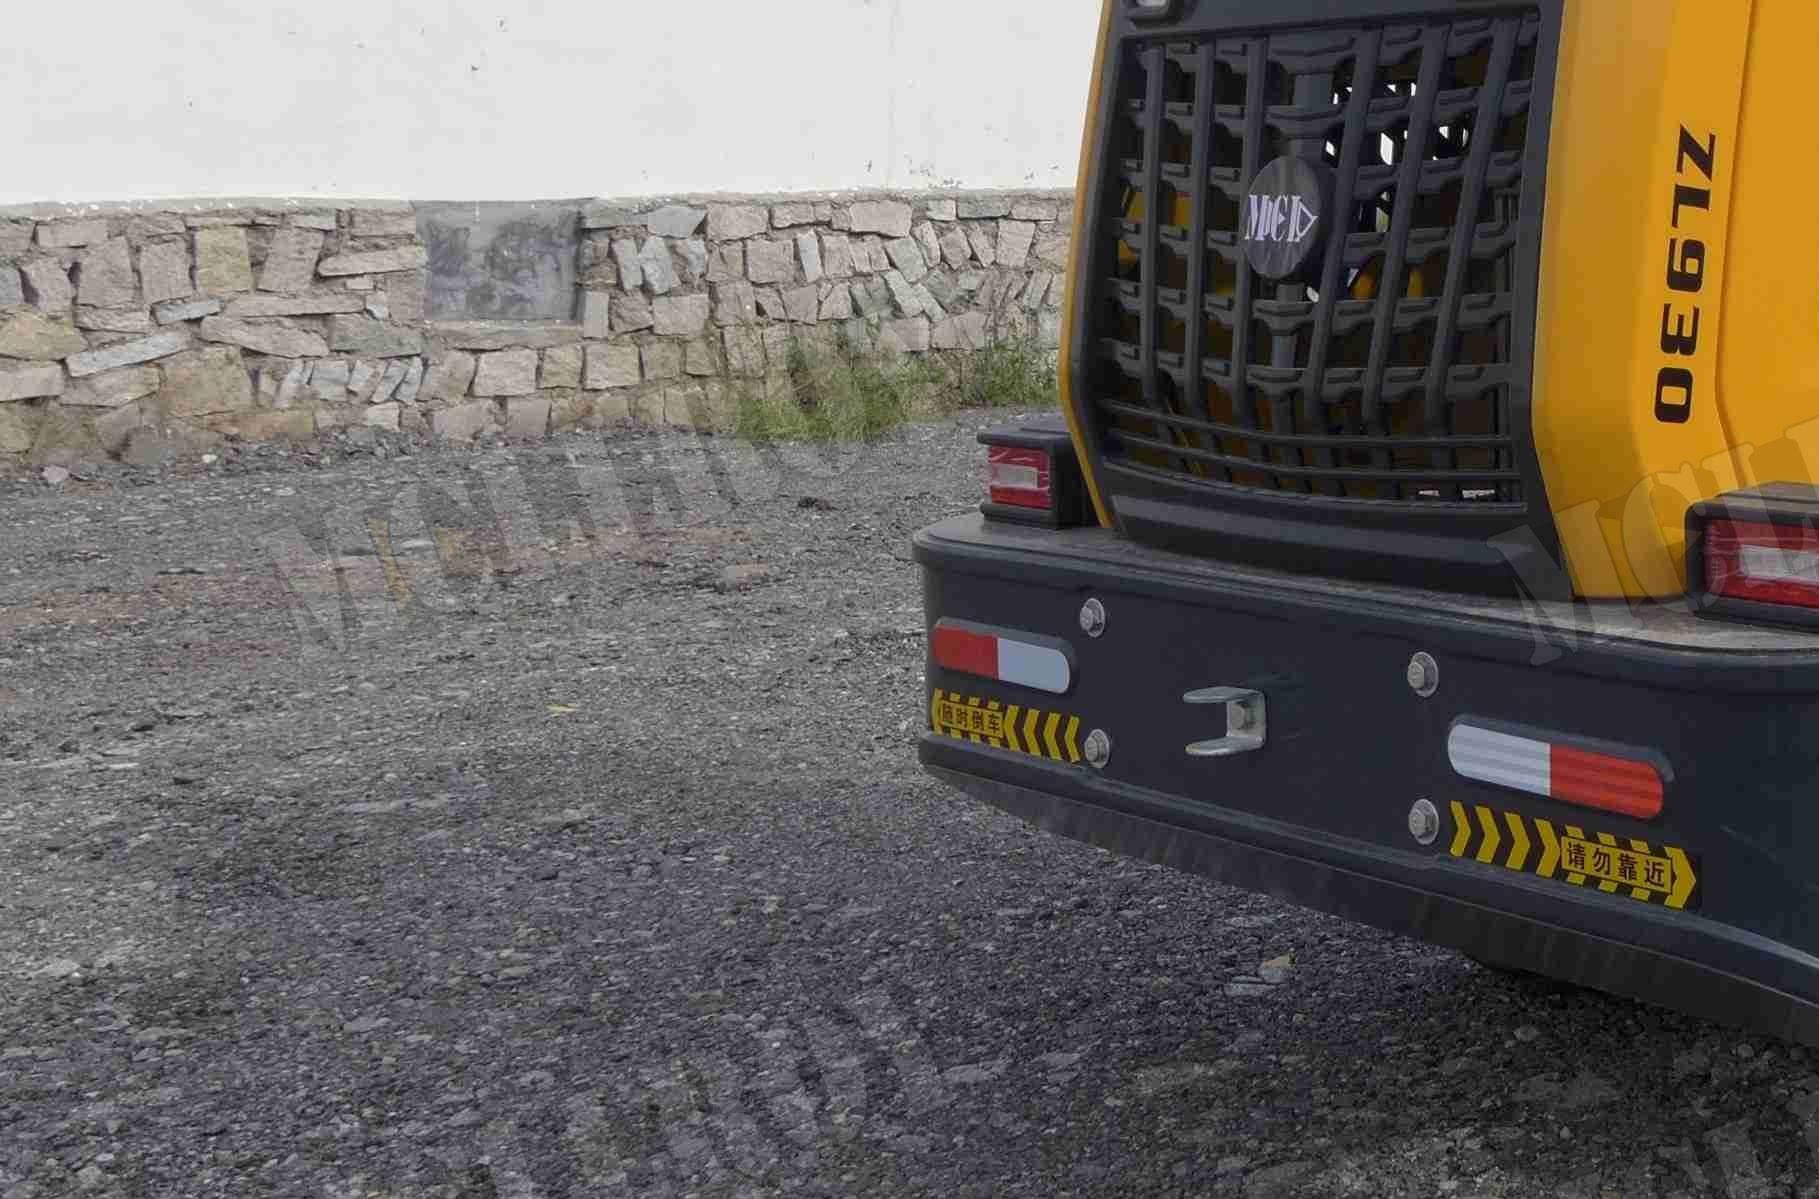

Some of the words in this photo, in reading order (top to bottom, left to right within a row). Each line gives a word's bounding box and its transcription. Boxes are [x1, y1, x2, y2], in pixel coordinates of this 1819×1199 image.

[1653, 123, 1716, 424] ZL930
[1567, 841, 1666, 888] 请勿靠近
